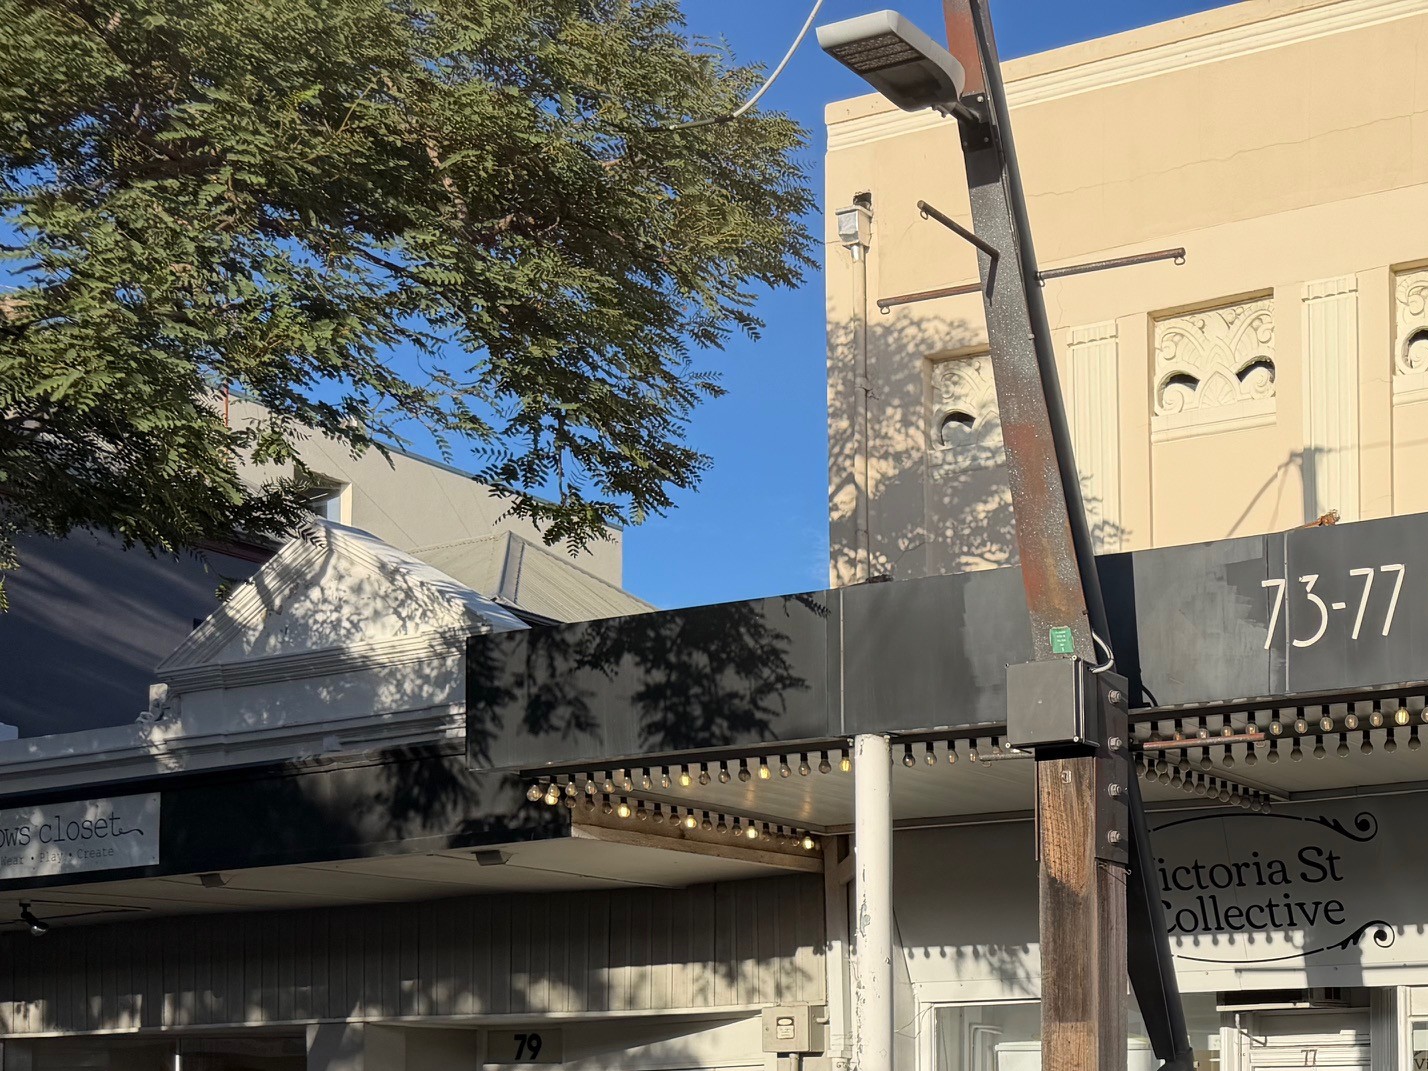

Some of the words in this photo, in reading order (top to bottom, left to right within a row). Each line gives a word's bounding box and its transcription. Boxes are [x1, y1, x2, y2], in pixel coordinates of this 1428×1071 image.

[1261, 563, 1406, 650] 73-77
[39, 811, 144, 844] closet
[1, 856, 24, 866] Wear
[40, 851, 63, 864] Play
[77, 847, 115, 860] Create
[1154, 851, 1293, 892] ictoria
[1297, 845, 1344, 883] St
[513, 1033, 543, 1060] 79
[1300, 1049, 1318, 1066] 77
